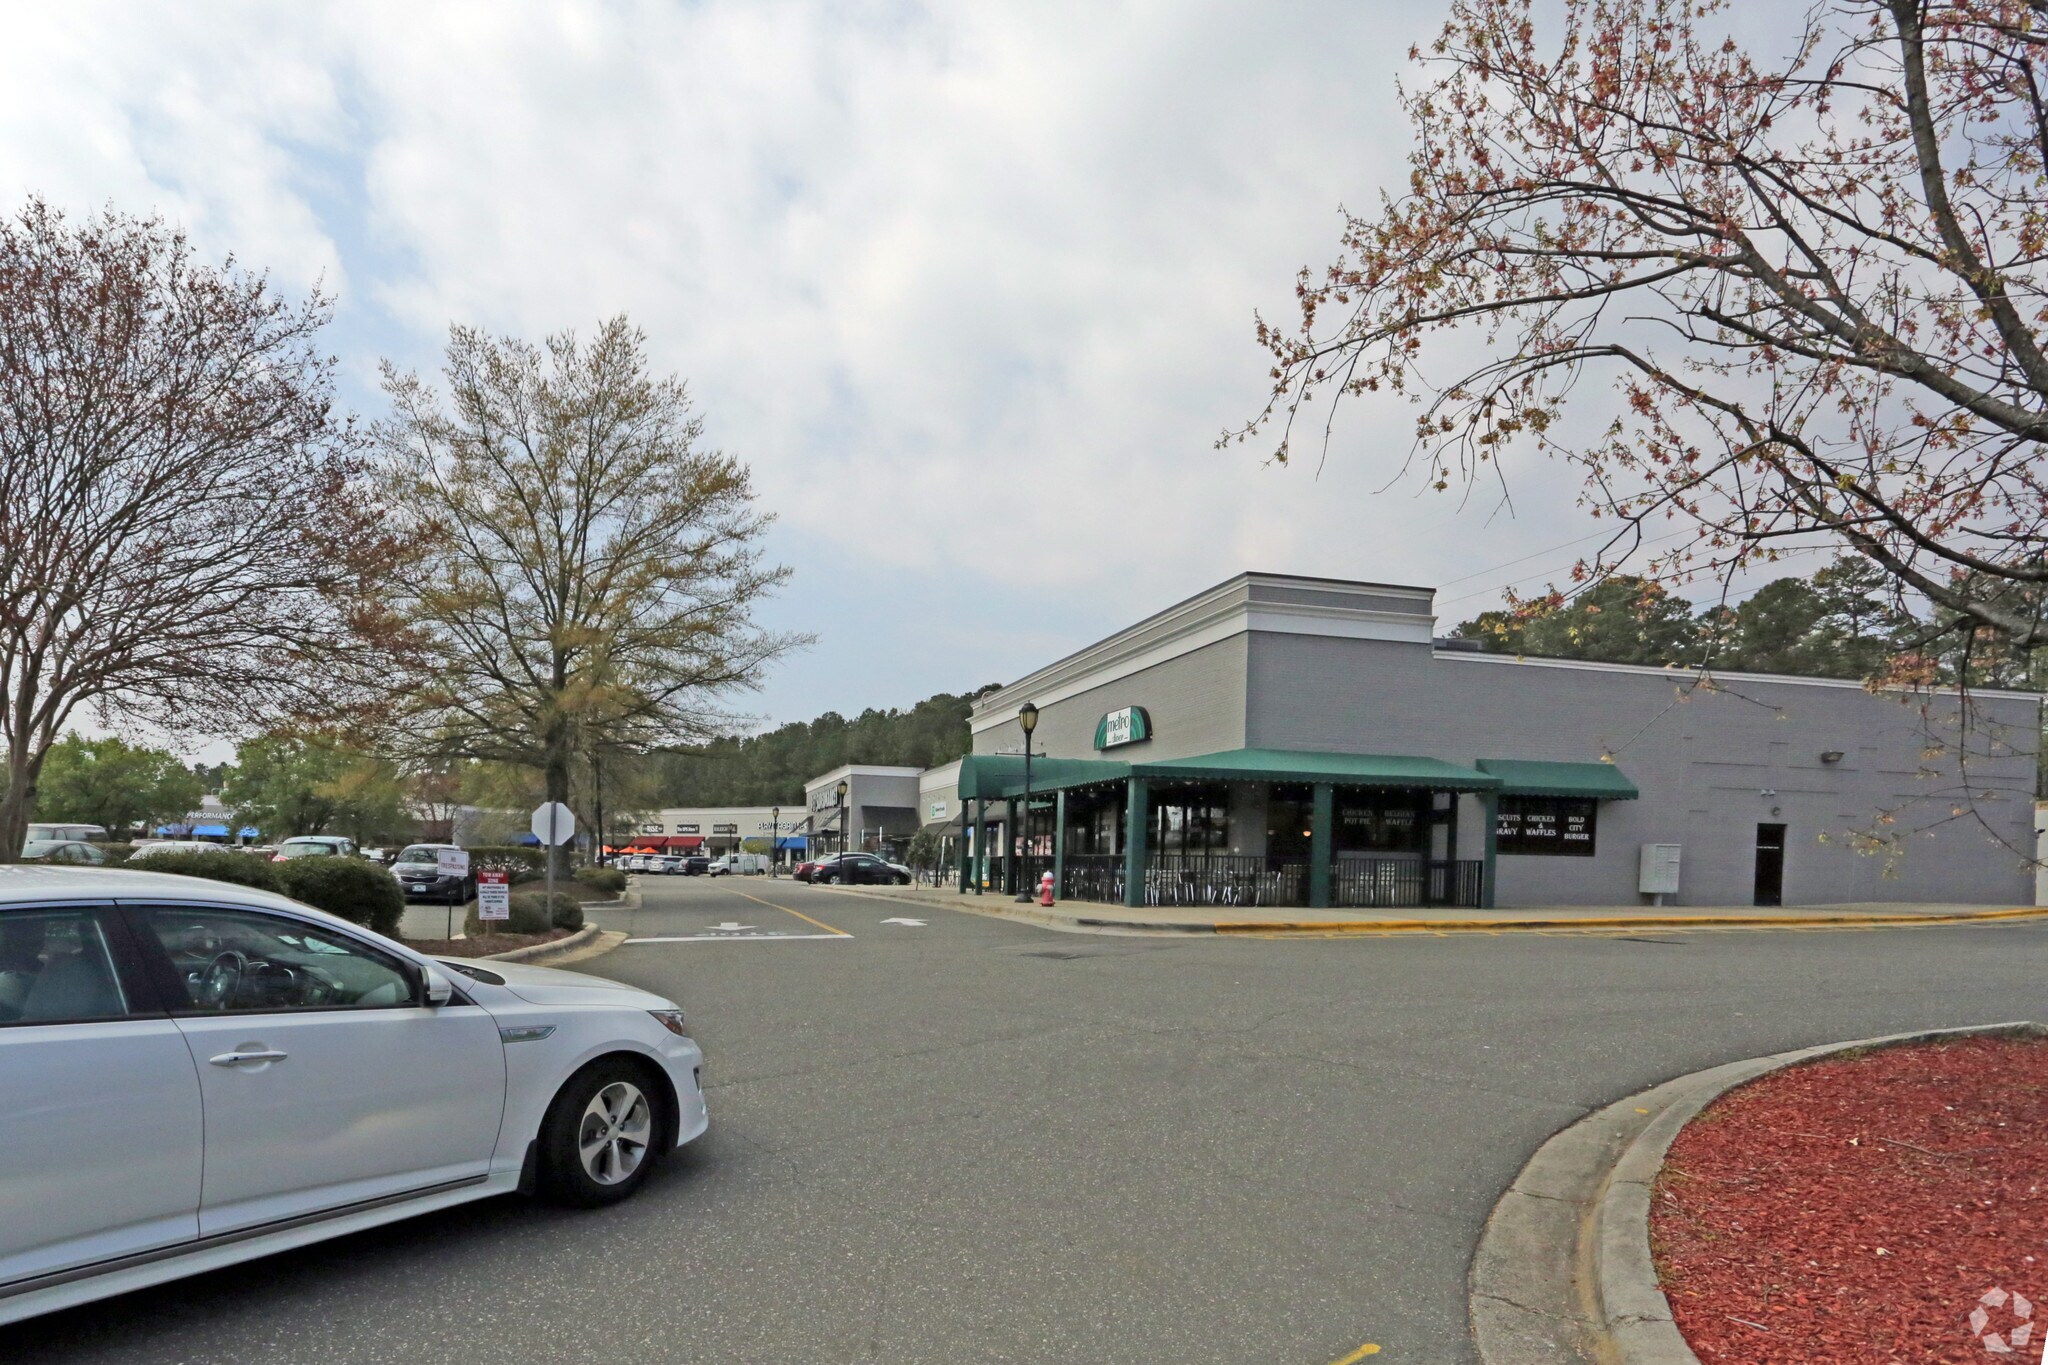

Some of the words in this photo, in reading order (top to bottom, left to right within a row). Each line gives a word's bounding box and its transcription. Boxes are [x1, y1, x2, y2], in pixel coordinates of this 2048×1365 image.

[1108, 712, 1129, 732] metro
[1497, 814, 1521, 822] SCUITS
[1525, 828, 1557, 836] WAFFLES
[1568, 824, 1584, 832] CITY
[1564, 833, 1590, 841] BURGER
